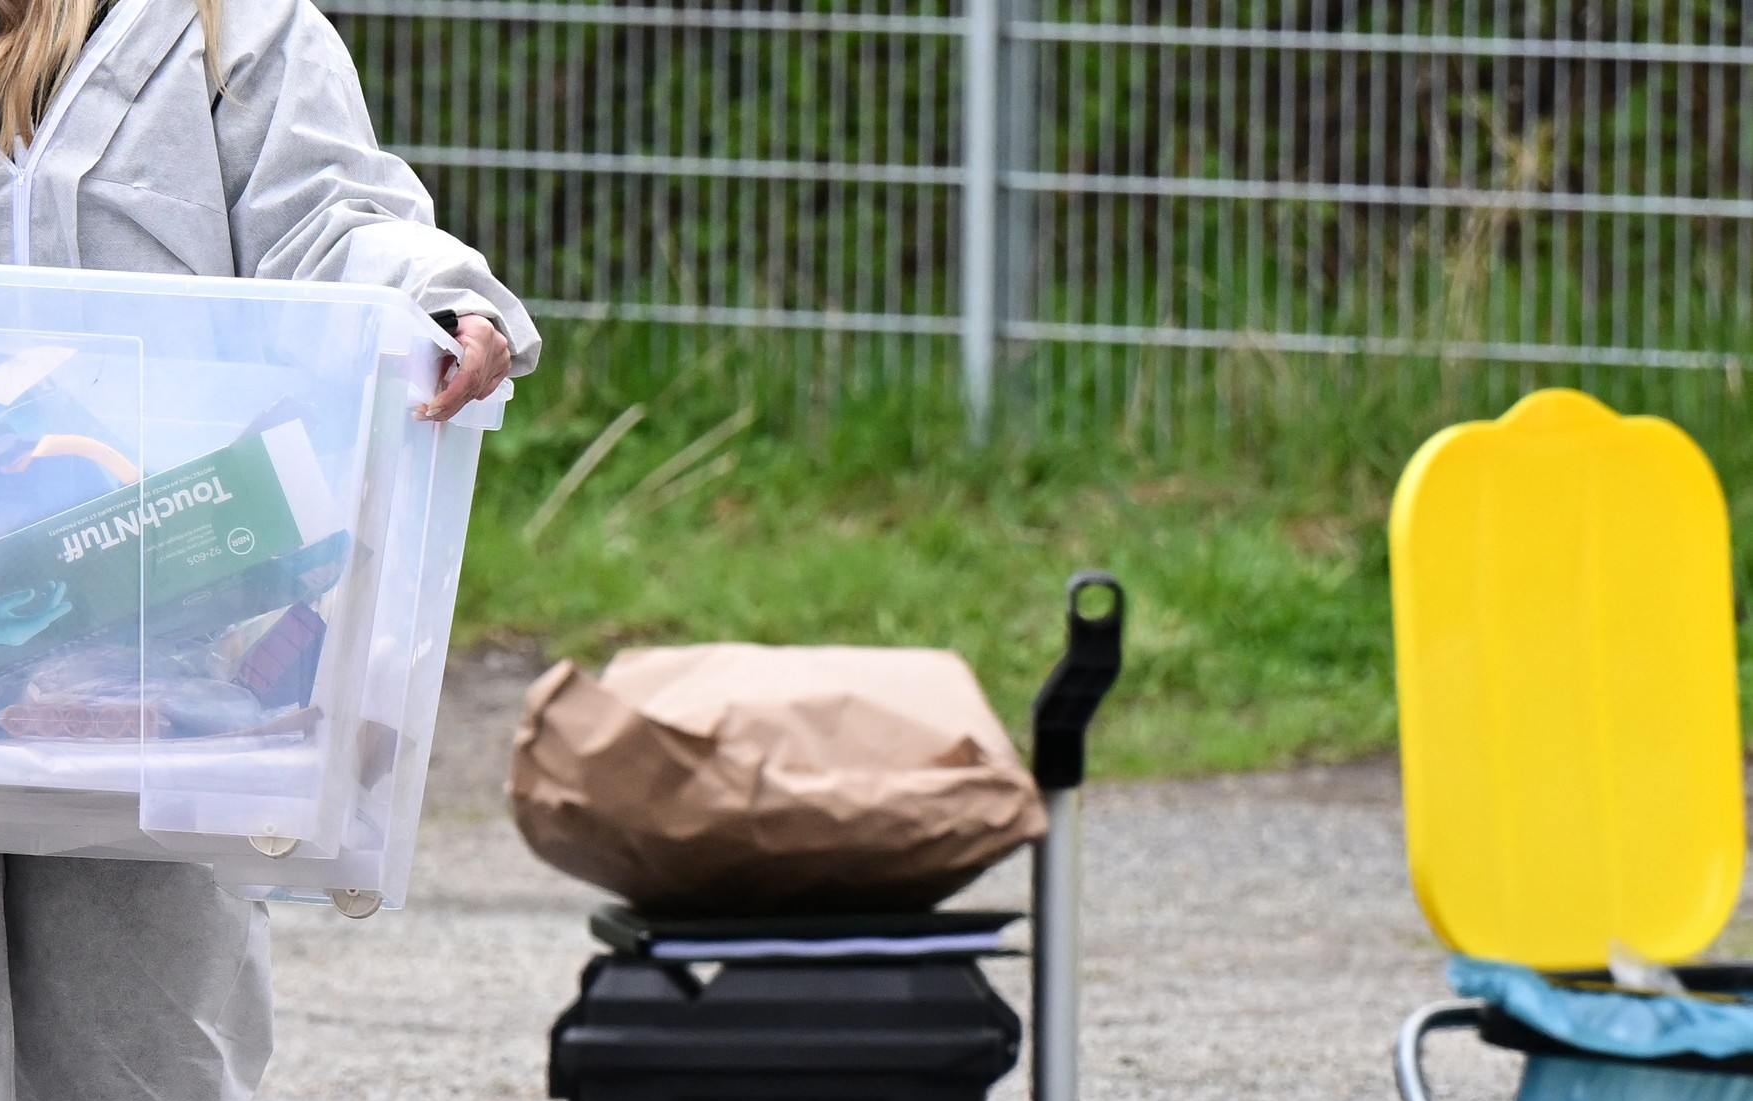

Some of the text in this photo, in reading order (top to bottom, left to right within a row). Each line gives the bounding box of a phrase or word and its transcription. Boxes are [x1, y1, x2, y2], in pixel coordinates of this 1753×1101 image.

[179, 466, 215, 483] PROTECTION
[98, 498, 138, 516] TRAVAILLEURS
[229, 534, 250, 546] NBR
[187, 546, 221, 565] 92-605
